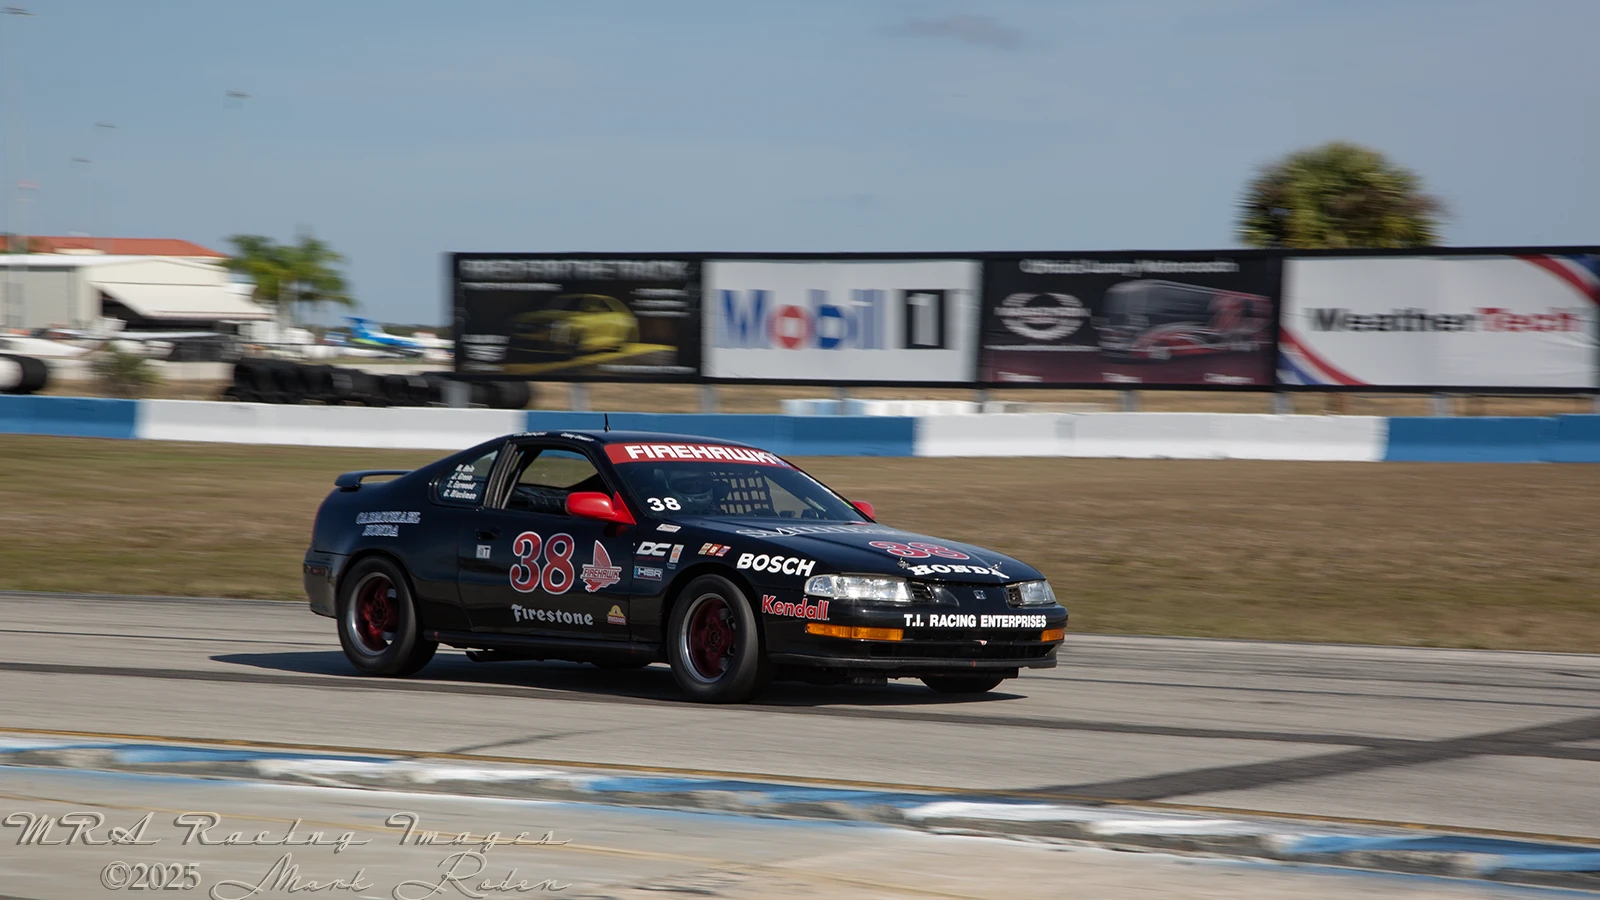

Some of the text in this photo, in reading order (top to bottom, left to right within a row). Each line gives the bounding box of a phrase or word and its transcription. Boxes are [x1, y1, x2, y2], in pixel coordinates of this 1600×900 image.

[713, 288, 944, 350] Mobil 1
[1305, 307, 1583, 332] WeatherTech
[624, 445, 777, 465] FIREHAWK
[647, 497, 682, 512] 38
[636, 541, 672, 557] DC
[868, 541, 970, 560] 38
[509, 531, 575, 595] 38
[637, 567, 662, 578] HSR
[736, 553, 816, 577] BOSCH
[908, 564, 1010, 580] HONDA
[583, 568, 619, 579] FIREHAWK
[511, 603, 594, 626] Firestone
[761, 593, 829, 621] Kendall
[904, 614, 1047, 628] T.I. RACING ENTERPRISES
